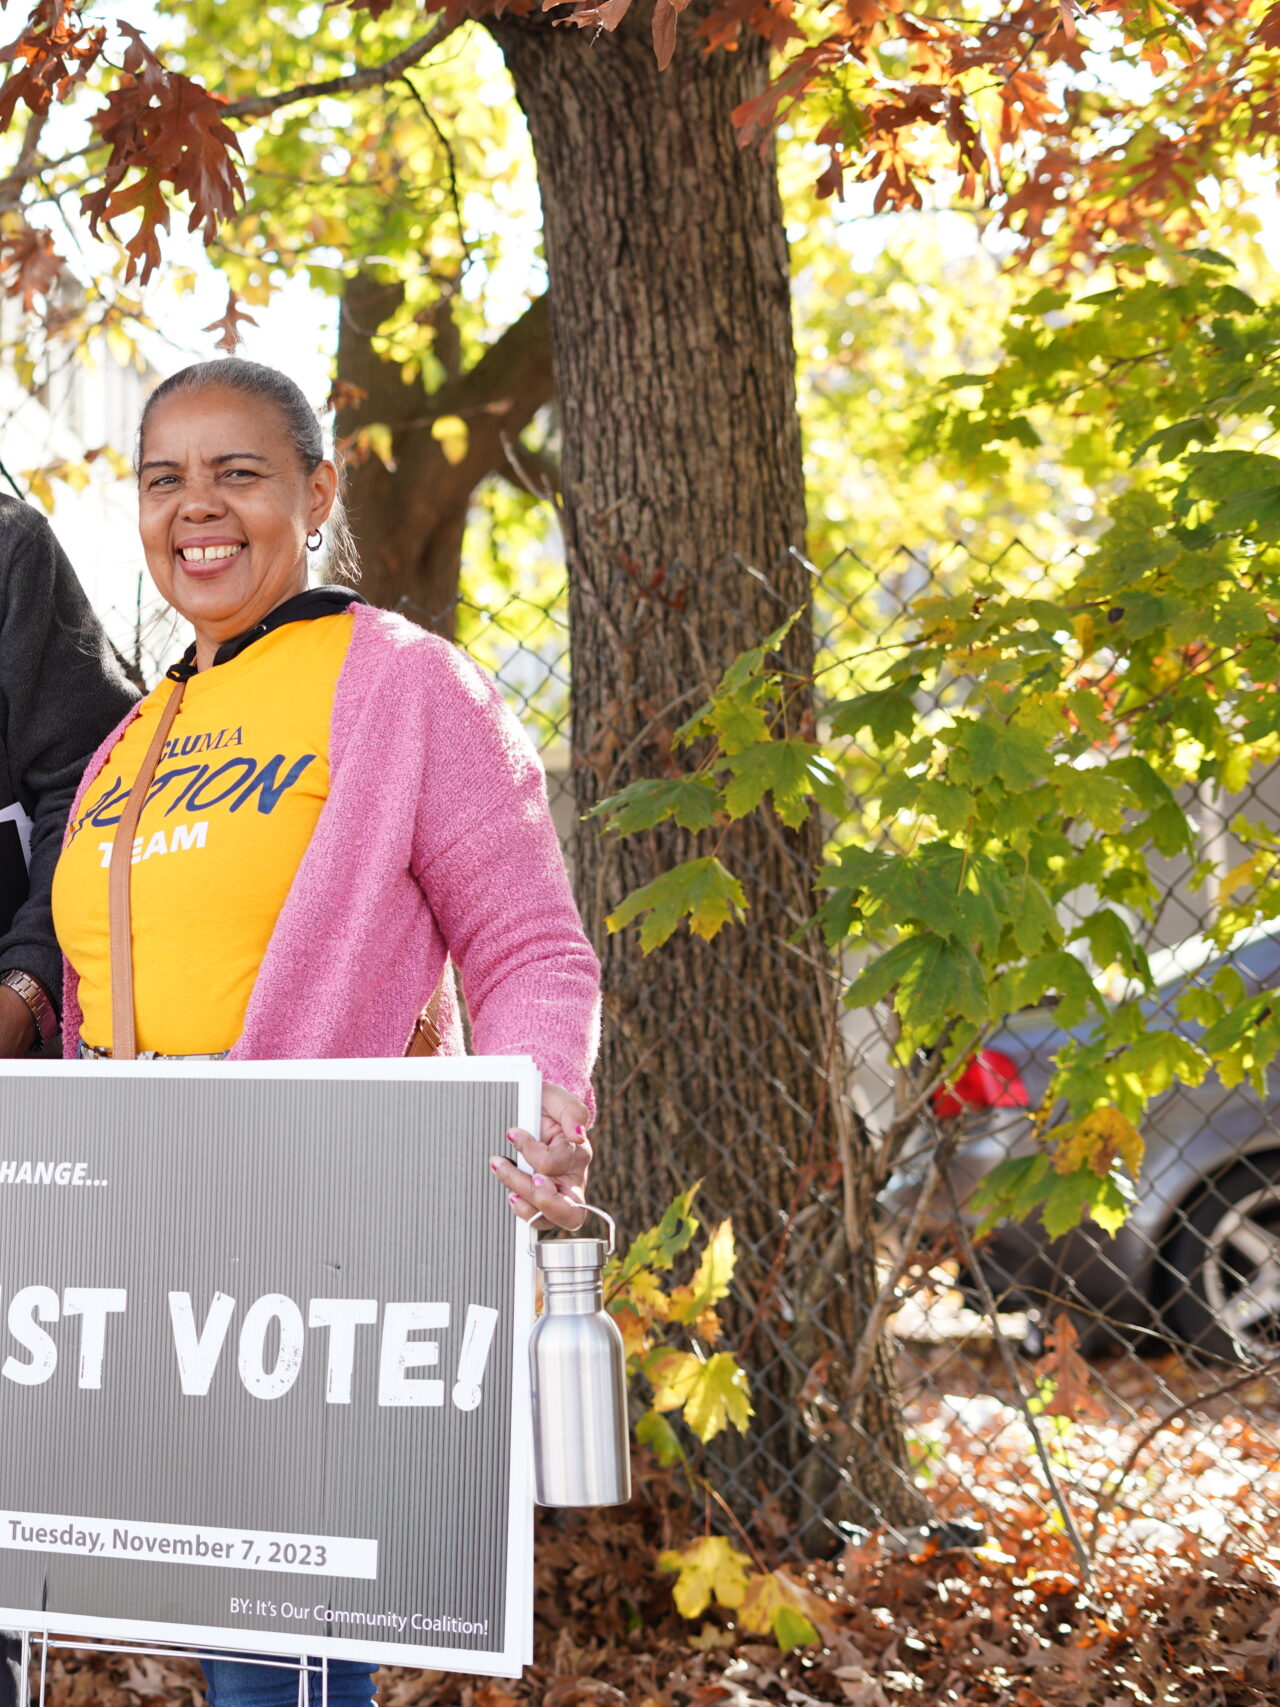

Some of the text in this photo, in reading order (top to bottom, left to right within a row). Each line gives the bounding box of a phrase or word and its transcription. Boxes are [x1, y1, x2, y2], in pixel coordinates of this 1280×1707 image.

[159, 725, 243, 764] CLUMA
[98, 821, 209, 868] TEAM
[168, 1290, 499, 1412] VOTE!
[8, 1520, 327, 1567] Tuesday, November 7, 2023
[230, 1597, 489, 1636] BY: It's Our Community Coalition!
